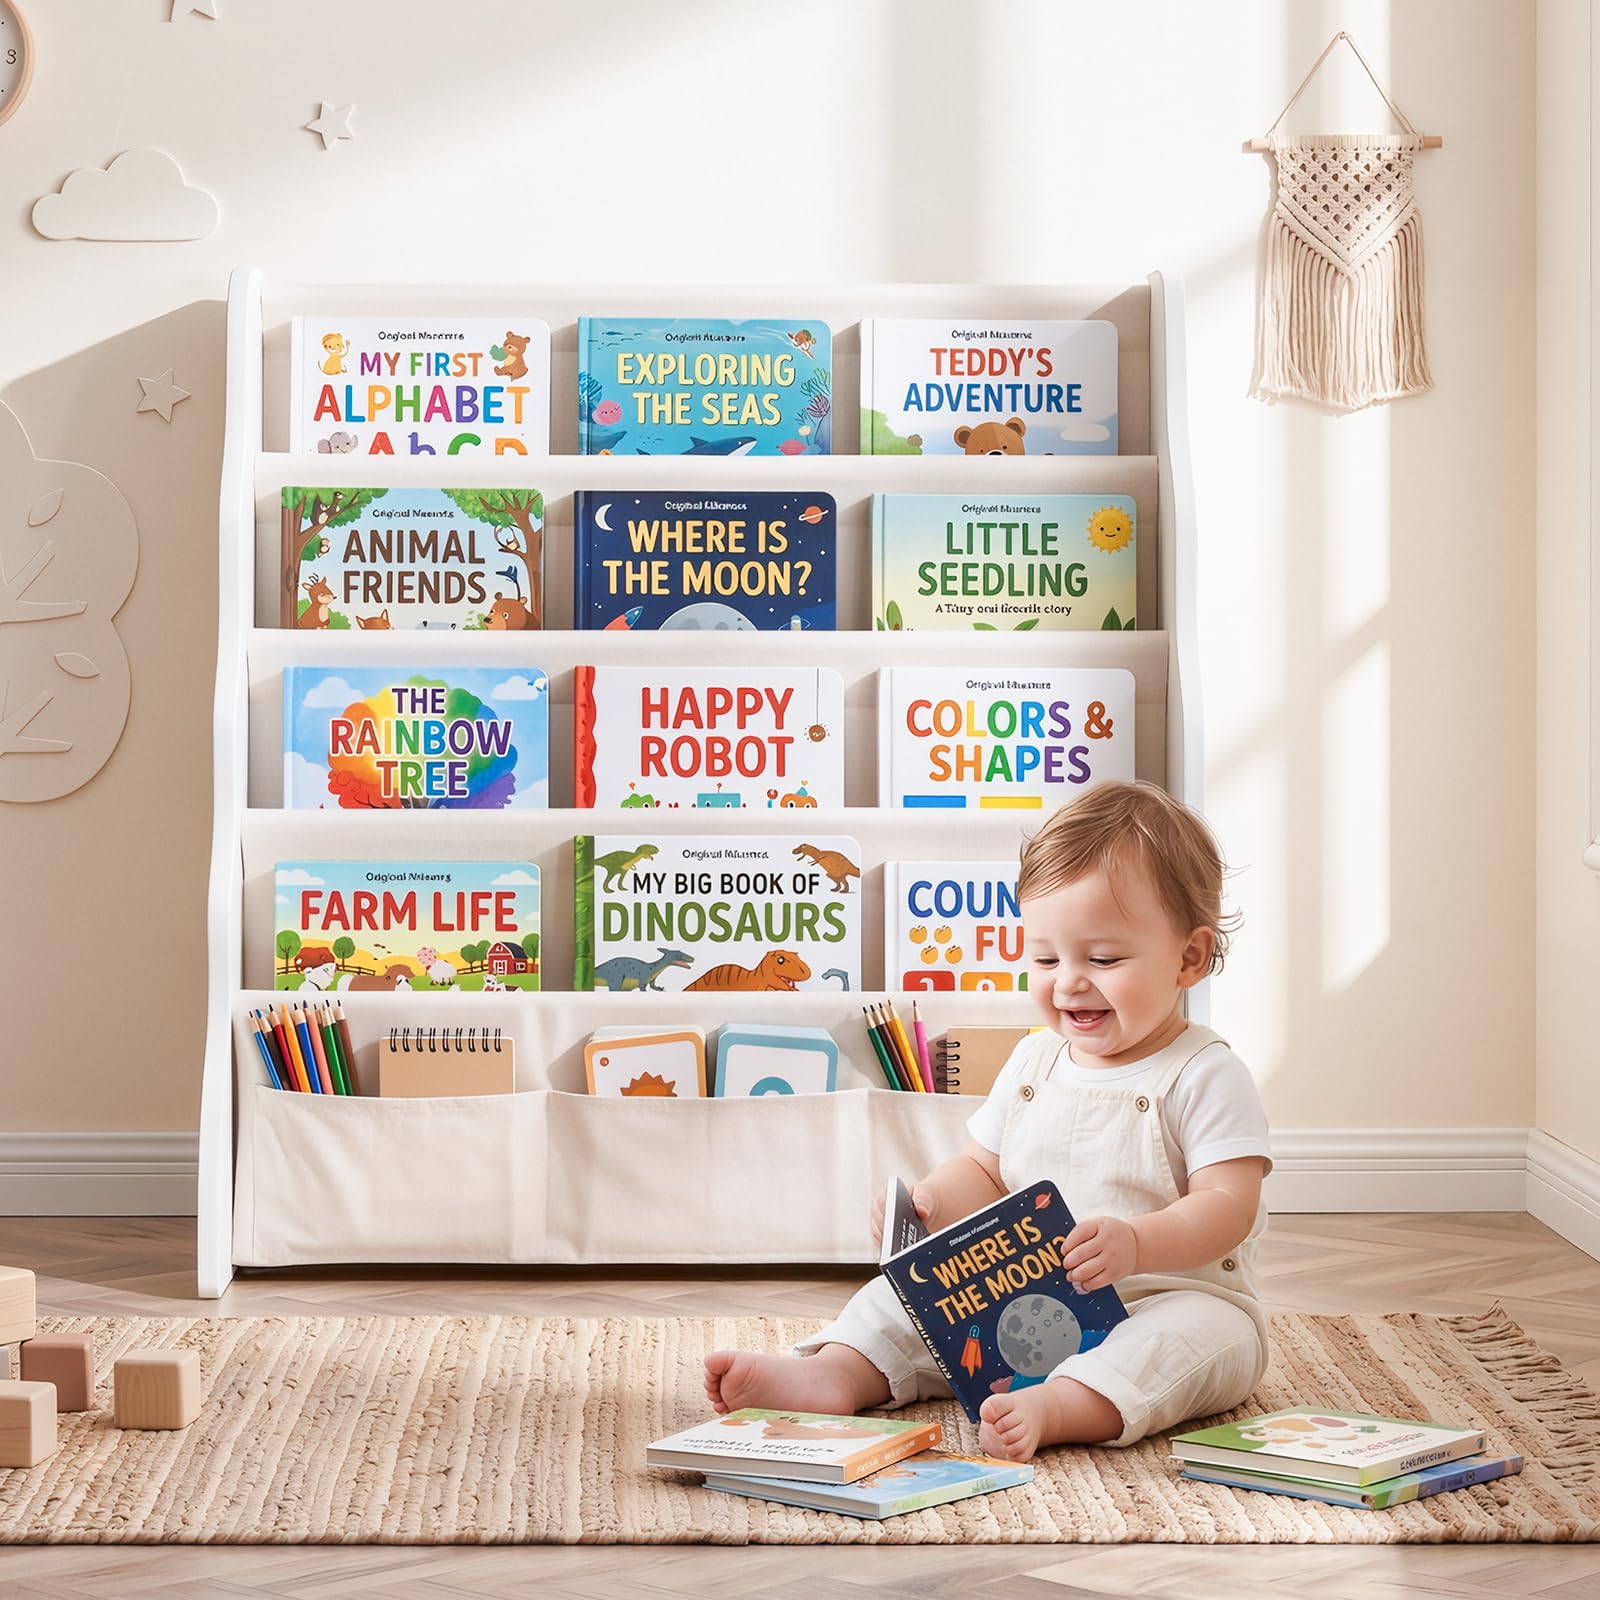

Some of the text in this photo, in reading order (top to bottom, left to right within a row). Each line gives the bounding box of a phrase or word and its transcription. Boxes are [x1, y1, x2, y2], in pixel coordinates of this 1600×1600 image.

[6, 49, 17, 65] 3
[360, 352, 483, 377] MY FIRST
[616, 353, 795, 386] EXPLORING
[930, 347, 1053, 377] TEDDY'S
[313, 384, 530, 424] ALPHABET
[632, 392, 782, 425] THE SEAS
[903, 382, 1082, 413] ADVENTURE
[342, 529, 486, 564] ANIMAL
[627, 519, 789, 554] WHERE IS
[946, 522, 1059, 556] LITTLE
[343, 570, 487, 605] FRIENDS
[602, 559, 813, 596] THE MOON?
[917, 561, 1088, 597] SEEDLING
[392, 687, 446, 714] THE
[641, 686, 795, 730] HAPPY
[331, 719, 512, 755] RAINBOW
[906, 699, 1114, 740] COLORS &
[640, 735, 795, 778] ROBOT
[929, 744, 1091, 784] SHAPES
[376, 760, 468, 796] TREE
[633, 873, 820, 894] MY BIG BOOK OF
[301, 890, 518, 932] FARM LIFE
[602, 902, 846, 943] DINOSAURS
[931, 1229, 1018, 1289] WHERE
[1013, 1215, 1043, 1247] IS
[935, 1288, 989, 1325] THE
